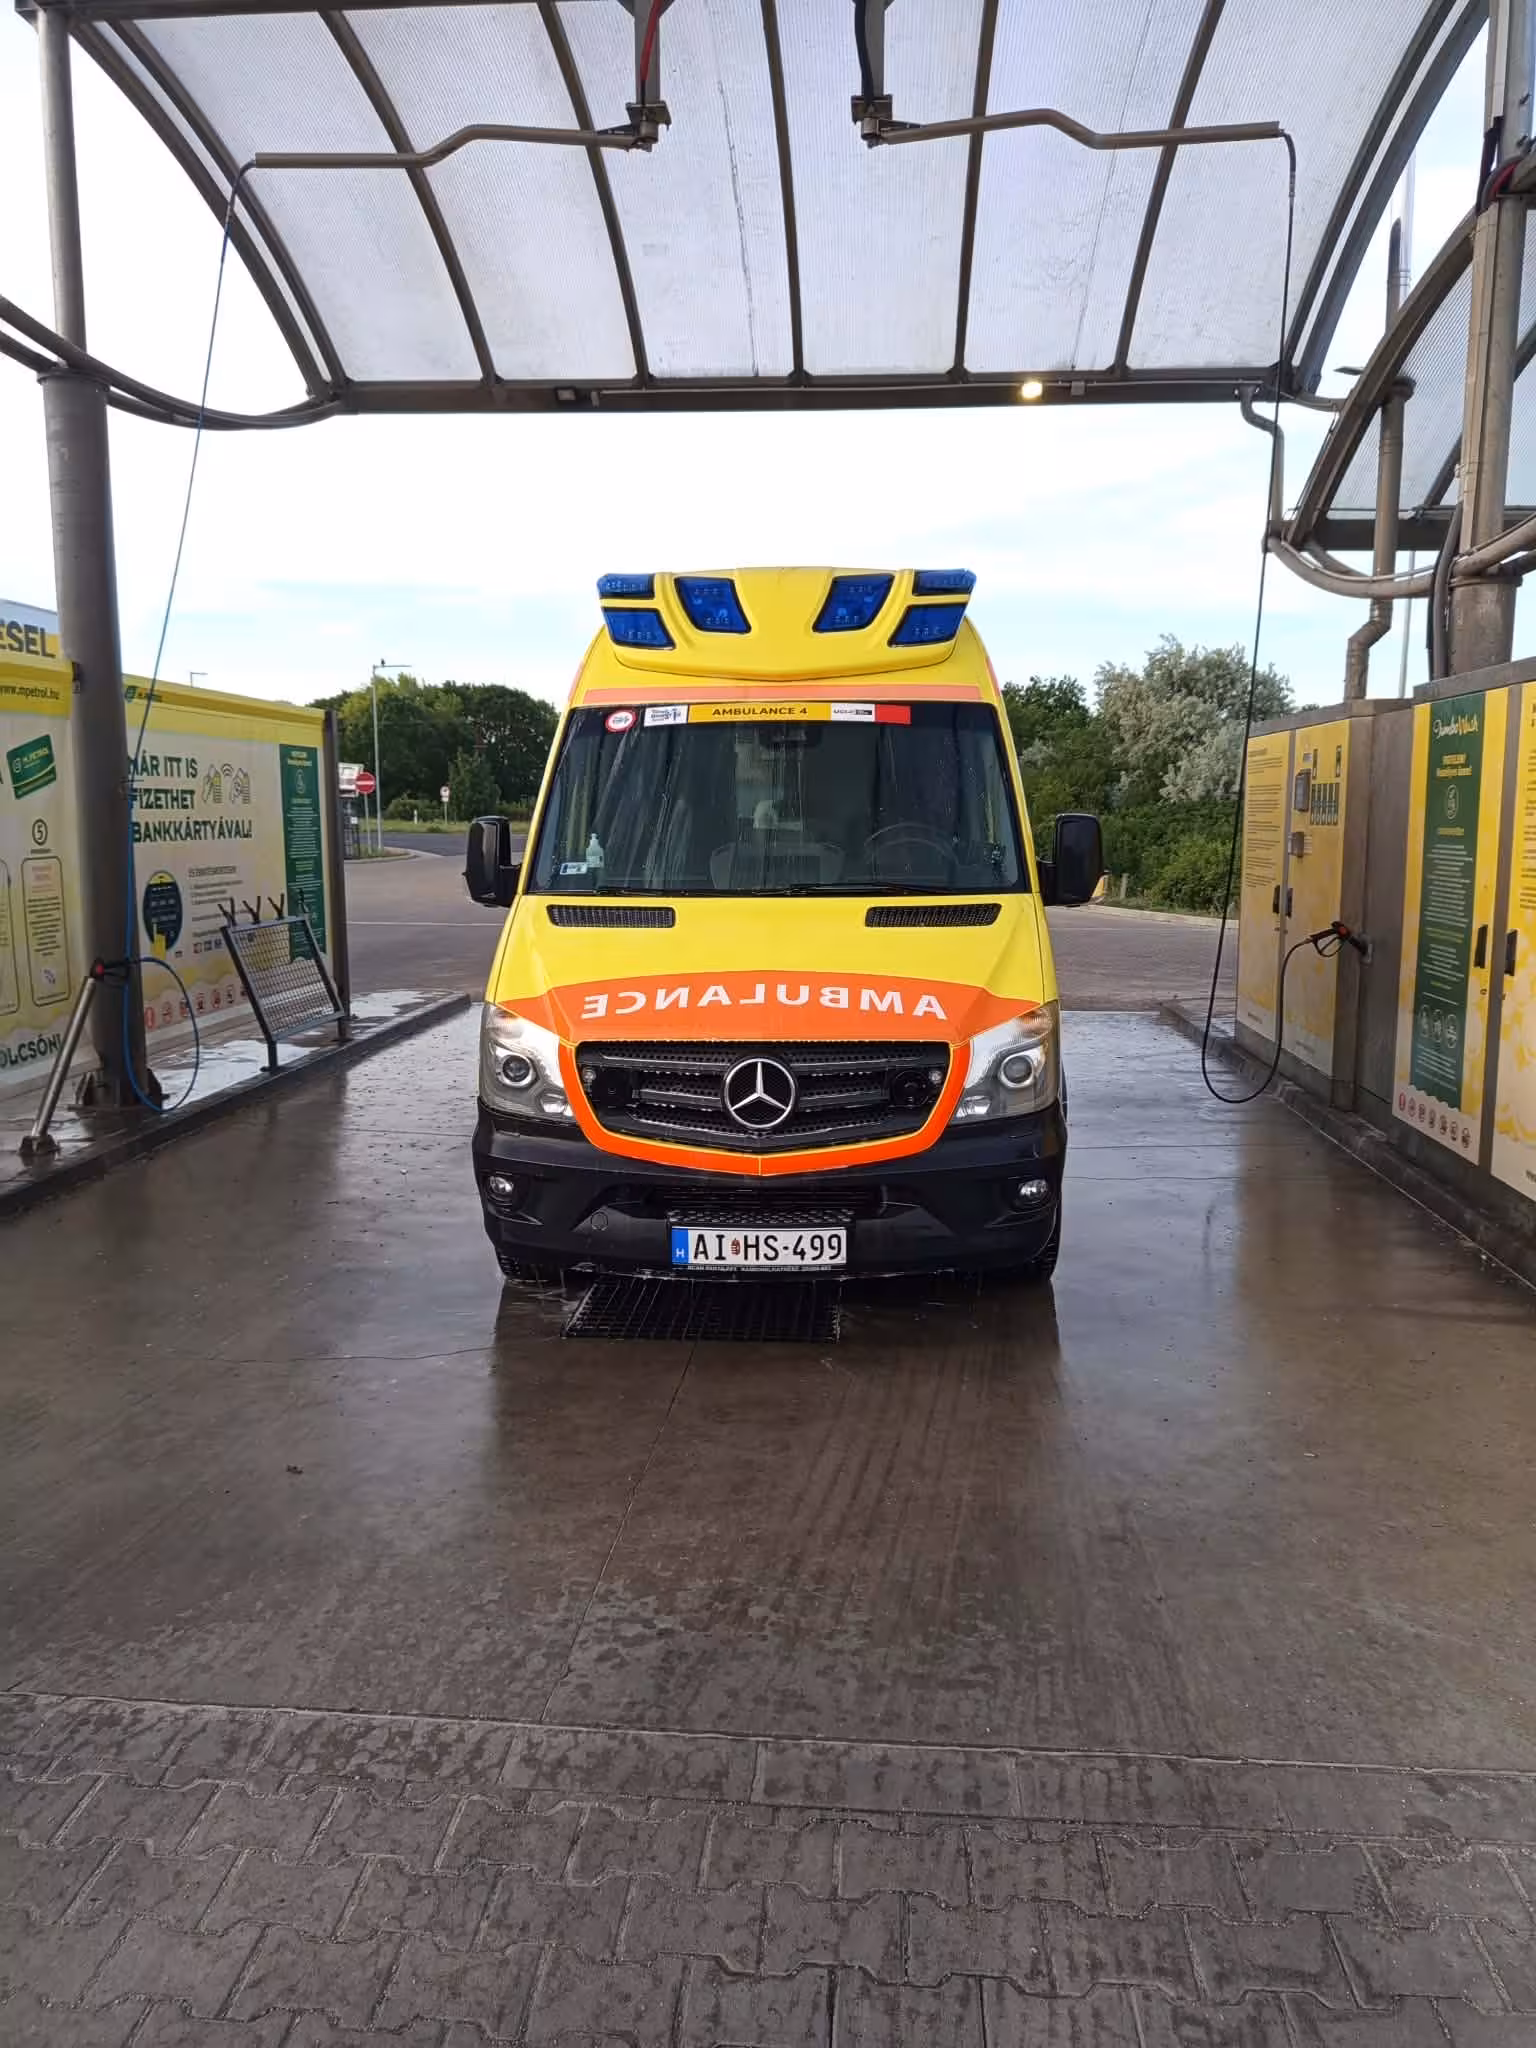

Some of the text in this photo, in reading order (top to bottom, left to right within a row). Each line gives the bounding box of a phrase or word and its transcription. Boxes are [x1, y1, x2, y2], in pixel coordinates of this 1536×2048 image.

[712, 707, 808, 716] AMBULANCE 4
[128, 749, 198, 778] MÁR ITT IS
[130, 788, 195, 809] FIZETHET
[131, 815, 252, 843] BANKKÁRTYÁVAL!
[675, 1247, 685, 1258] H
